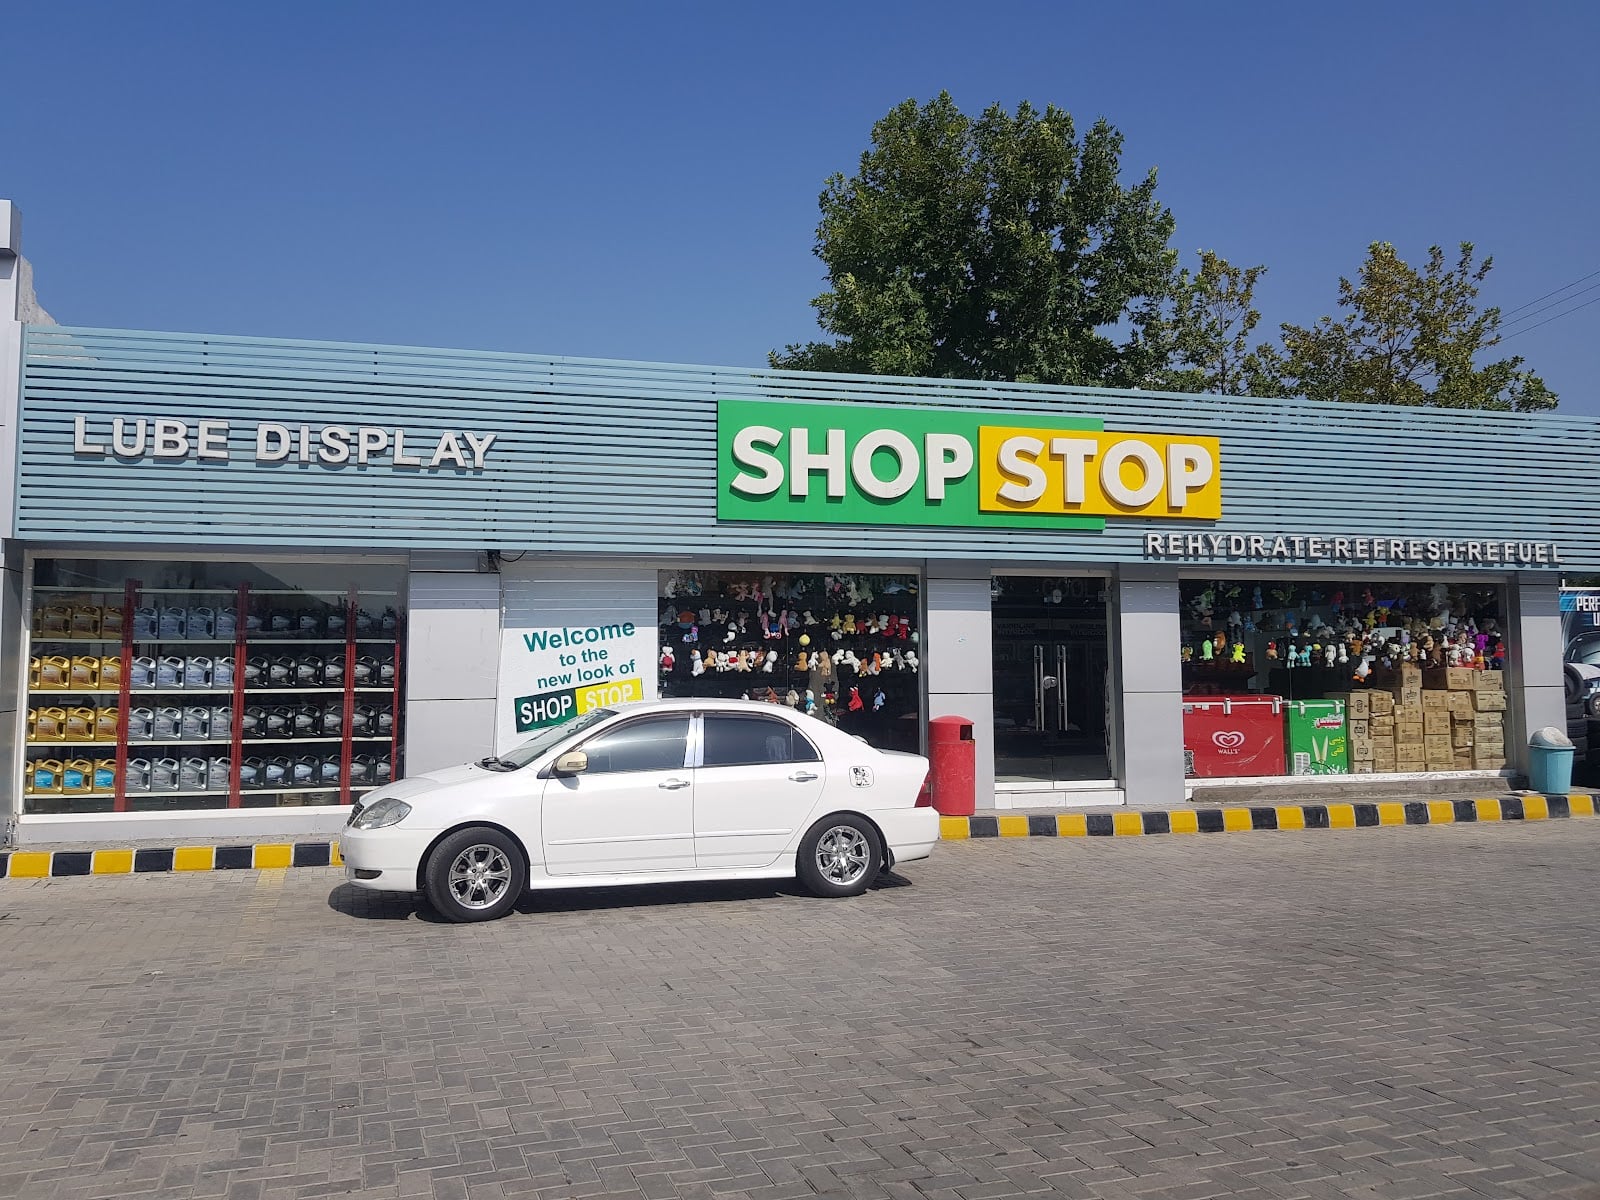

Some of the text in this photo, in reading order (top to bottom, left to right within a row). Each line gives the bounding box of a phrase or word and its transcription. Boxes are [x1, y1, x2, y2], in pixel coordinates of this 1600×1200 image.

[74, 415, 498, 469] LUBE DISPLAY
[731, 425, 1214, 508] SHOP STOP
[523, 621, 635, 652] Welcome
[537, 659, 635, 688] new look of
[559, 648, 608, 667] to the
[520, 684, 634, 725] SHOP STOP
